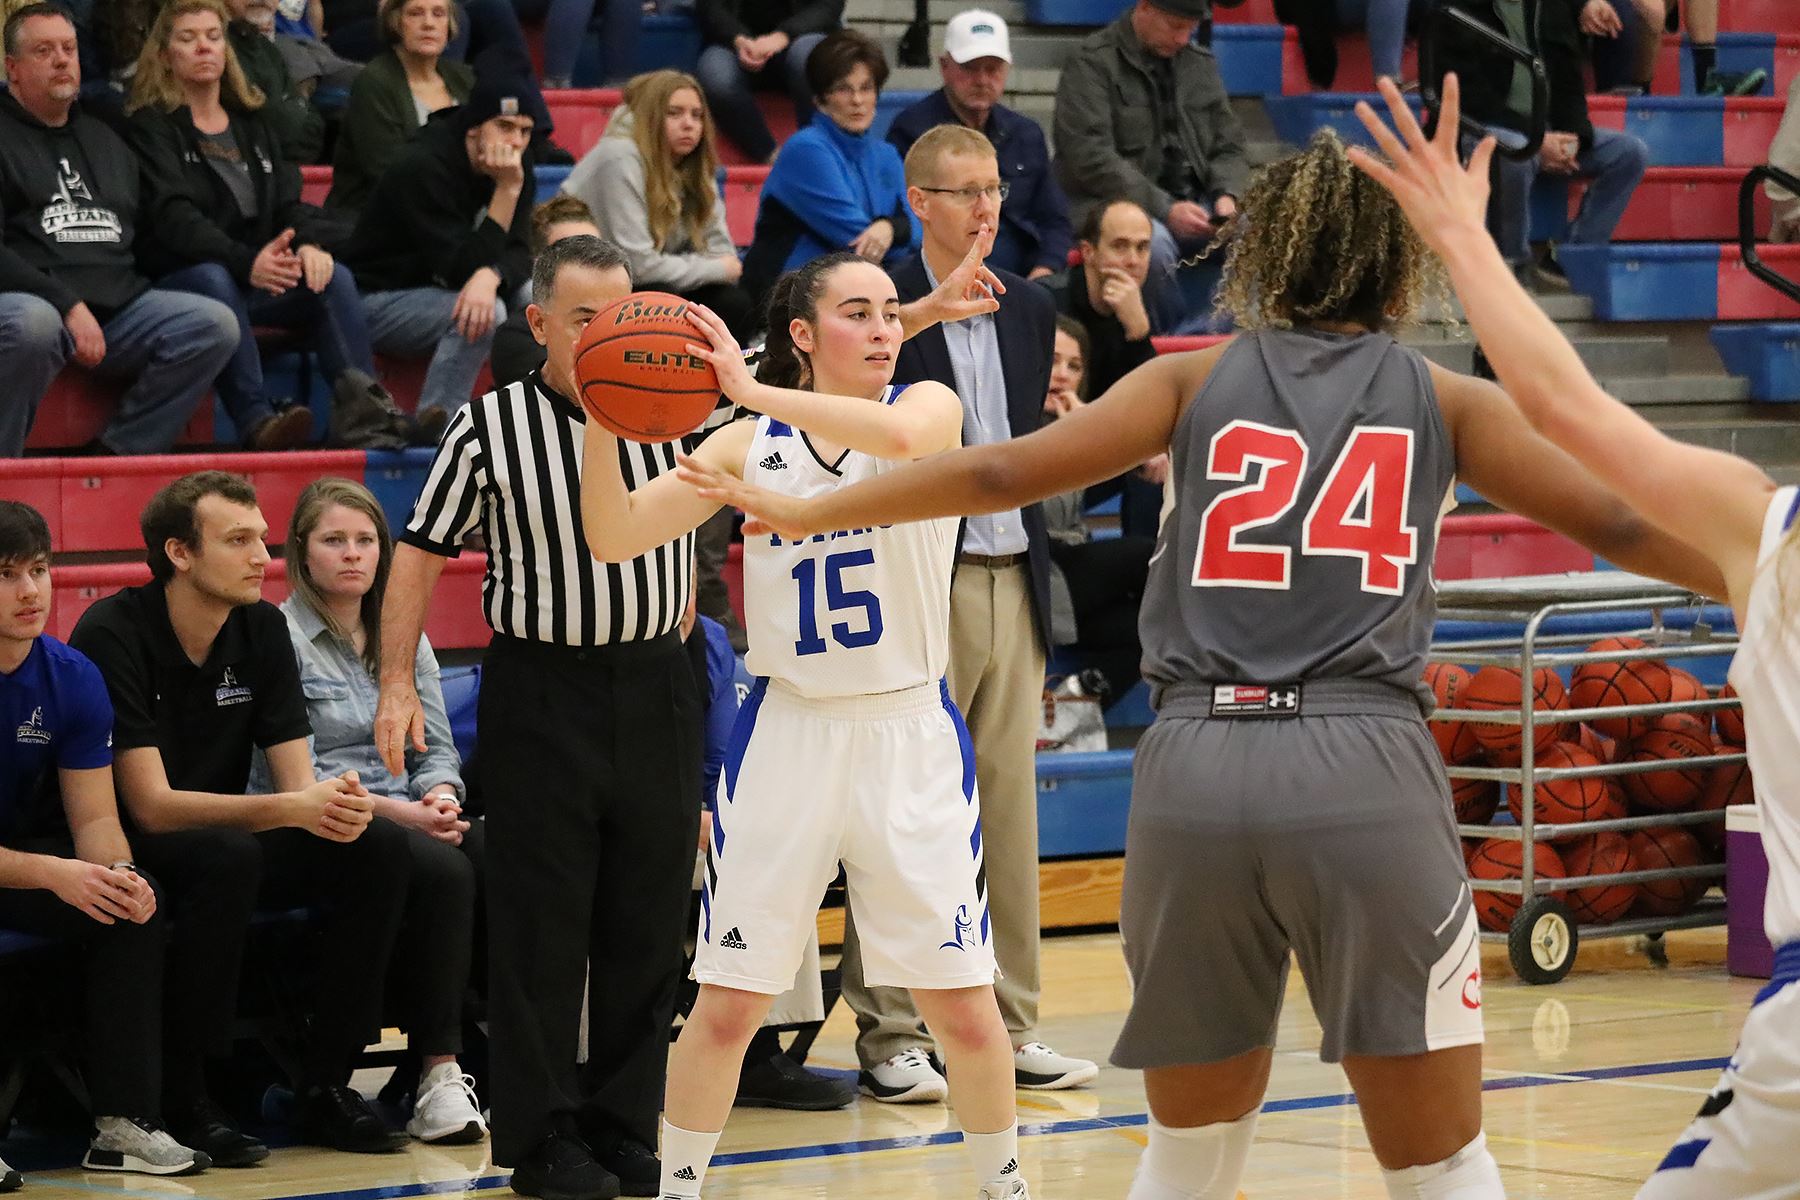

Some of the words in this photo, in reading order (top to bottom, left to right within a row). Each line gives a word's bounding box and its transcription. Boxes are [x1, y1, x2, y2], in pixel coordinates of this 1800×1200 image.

[615, 301, 689, 326] Bad
[624, 350, 705, 370] ELITE
[1191, 419, 1417, 596] 24
[791, 548, 884, 656] 15
[720, 940, 747, 950] adidas
